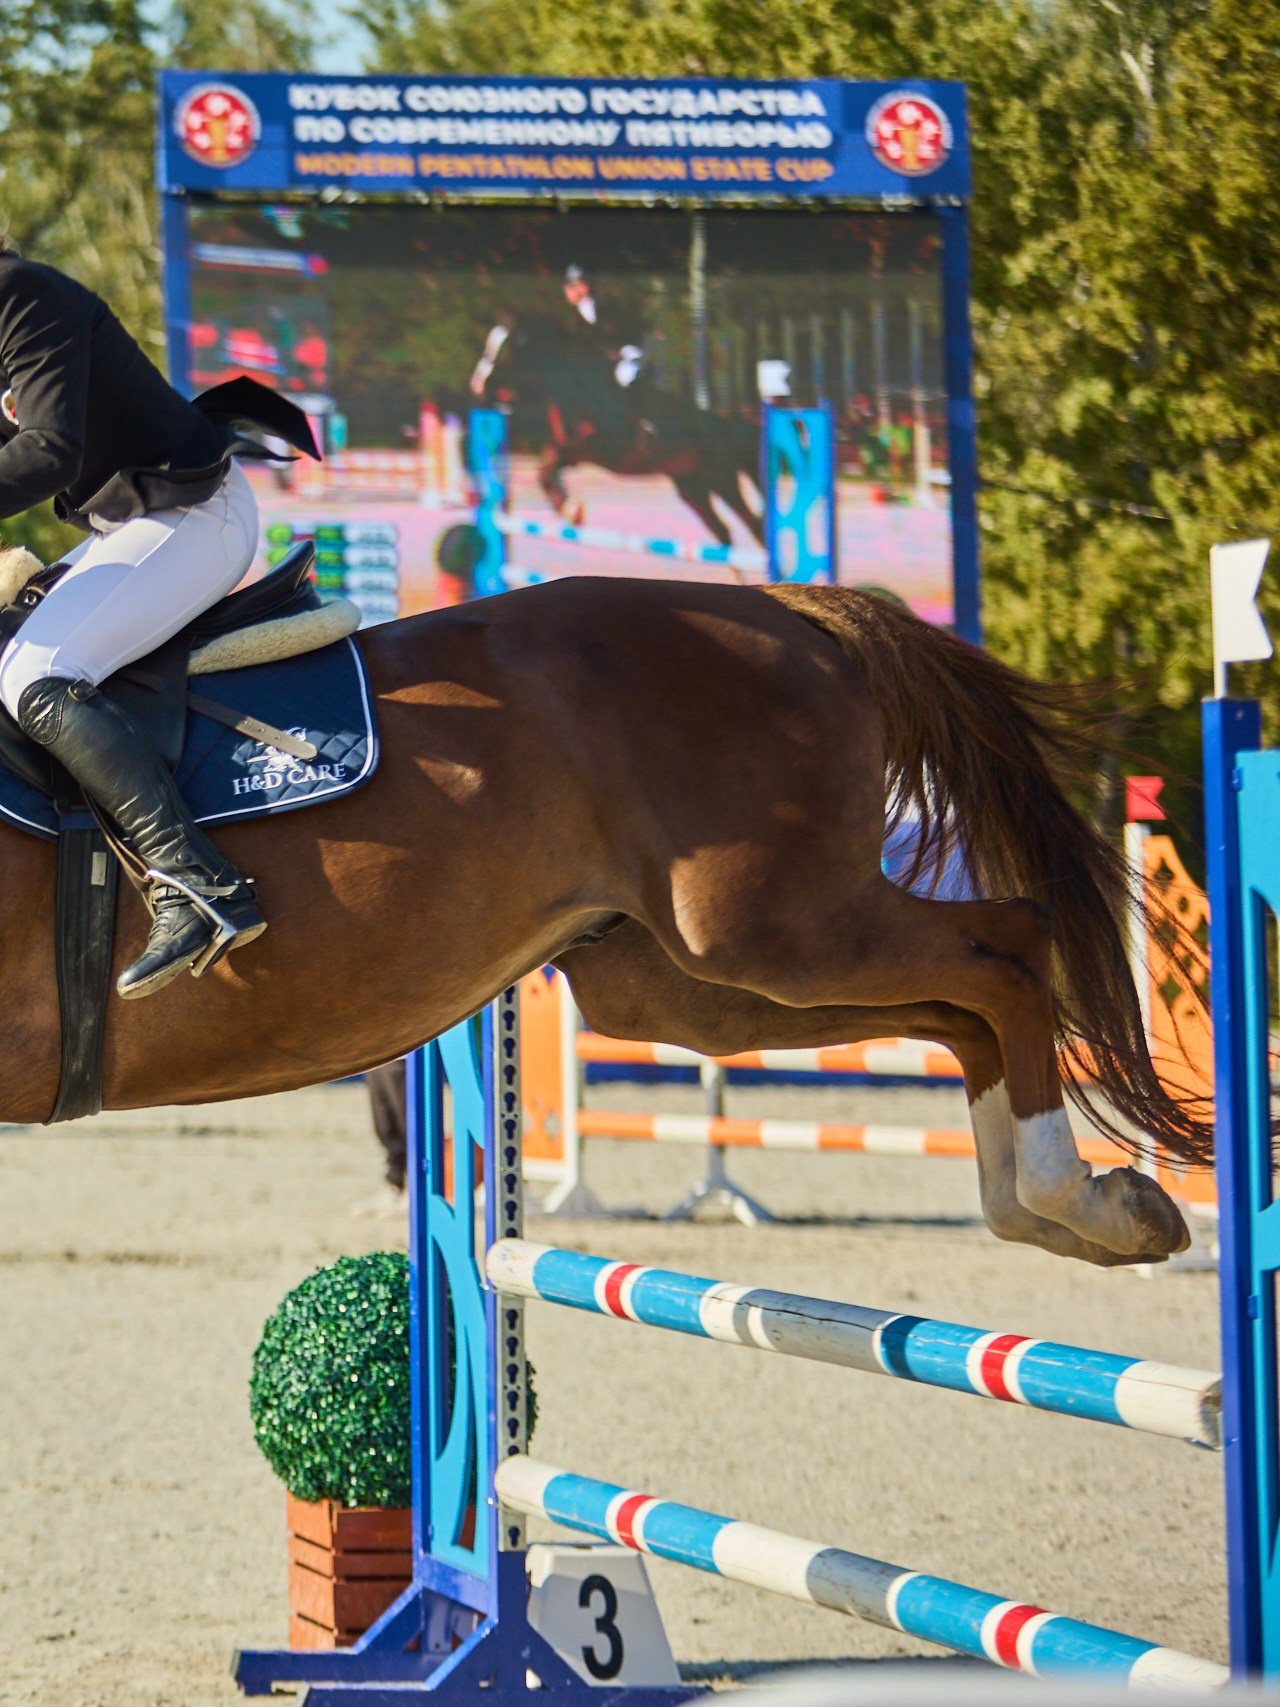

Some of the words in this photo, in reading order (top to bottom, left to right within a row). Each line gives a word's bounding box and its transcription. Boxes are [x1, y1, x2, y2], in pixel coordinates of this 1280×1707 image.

[288, 84, 402, 111] КУБОК
[404, 85, 587, 115] СОЮЗНОГО
[590, 87, 827, 118] ГОСУДАРСТВА
[293, 115, 346, 143] ПО
[348, 115, 621, 147] СОВРЕМЕННОМУ
[625, 120, 833, 149] ПЯТИБОРЬЮ
[295, 152, 415, 177] MODERN
[418, 153, 595, 180] PENTATHLON
[597, 155, 687, 180] UNION
[690, 156, 774, 182] STATE
[775, 157, 834, 182] CUP
[232, 772, 283, 796] H&D
[286, 762, 347, 785] CARE
[579, 1574, 624, 1681] 3
